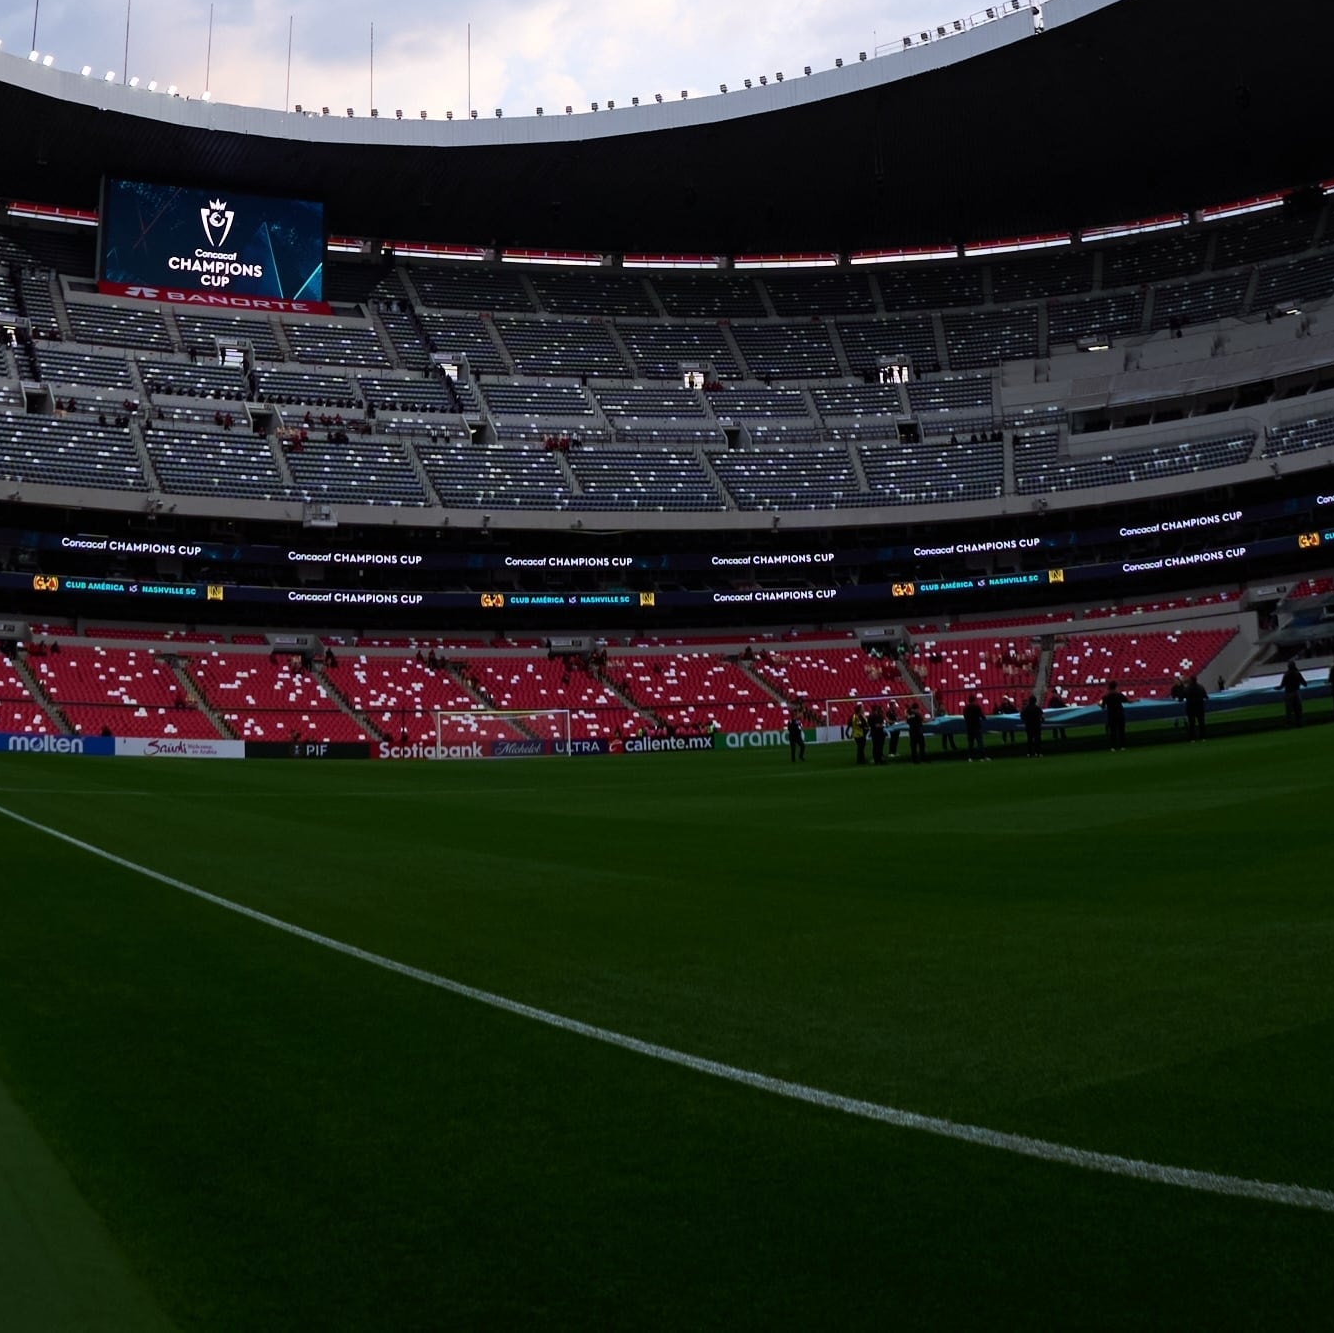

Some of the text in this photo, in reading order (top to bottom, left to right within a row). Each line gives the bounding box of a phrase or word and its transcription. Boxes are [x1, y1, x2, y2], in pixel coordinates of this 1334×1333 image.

[194, 248, 237, 261] Concacaf
[168, 256, 263, 278] CHAMPIONS
[200, 274, 230, 288] CUP
[166, 291, 309, 312] BANORTE
[1120, 511, 1242, 536] Concacaf CHAMPIONS CUP
[62, 538, 201, 555] Concacaf CHAMPIONS CUP
[914, 538, 1040, 556] Concacaf CHAMPIONS CUP
[288, 552, 422, 564] Concacaf CHAMPIONS CUP
[505, 557, 632, 566] Concacaf CHAMPIONS CUP
[712, 554, 834, 565] Concacaf CHAMPIONS CUP
[1123, 548, 1246, 571] Concacaf CHAMPIONS CUP
[66, 581, 86, 589] CLUB
[88, 582, 124, 591] AMÉRICA
[142, 586, 184, 594] NASHVILLE
[941, 581, 973, 589] AMÉRICA
[989, 576, 1027, 585] NASHVILLE
[289, 592, 422, 603] Concacaf CHAMPIONS CUP
[531, 596, 564, 604] AMÉRICA
[714, 590, 836, 601] Concacaf CHAMPIONS CUP
[8, 734, 84, 754] molten
[144, 739, 187, 757] Saudi
[378, 741, 483, 759] Scotiabank
[625, 734, 713, 752] caliente.mx
[306, 744, 328, 757] PIF
